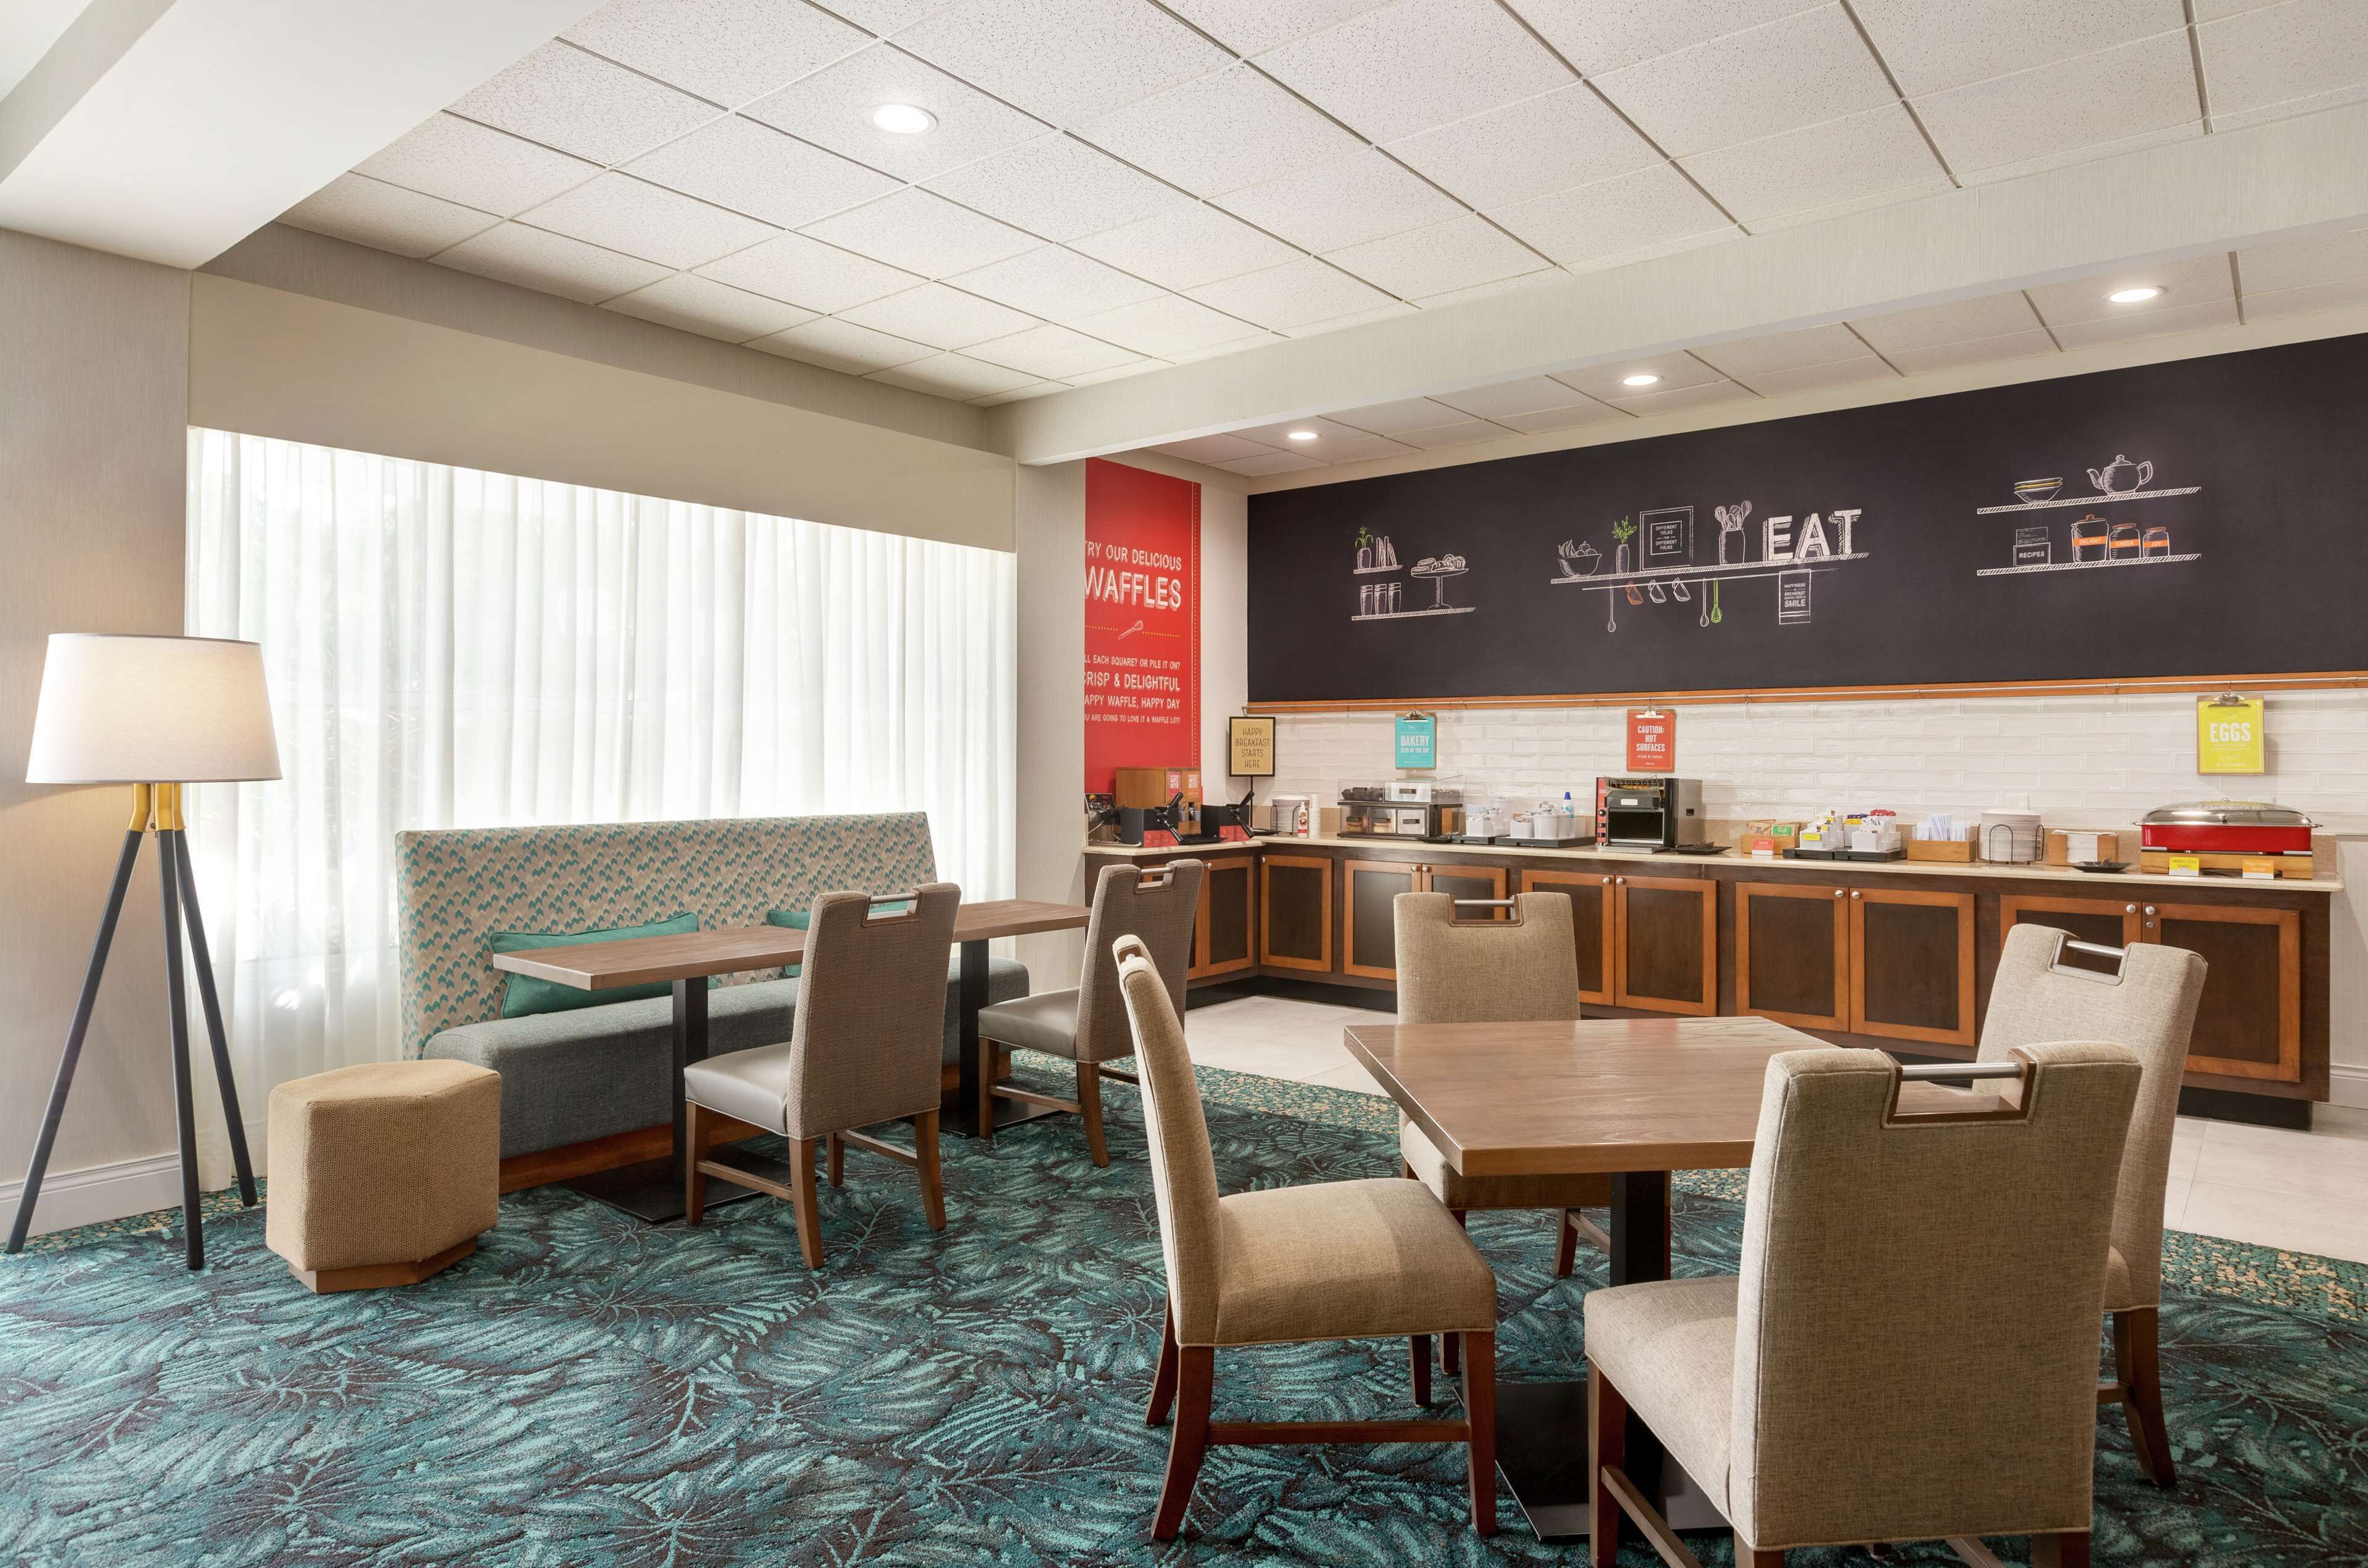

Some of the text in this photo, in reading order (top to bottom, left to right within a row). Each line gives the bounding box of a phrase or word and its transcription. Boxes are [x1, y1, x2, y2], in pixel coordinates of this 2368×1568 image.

[1763, 509, 1862, 561] EAT
[1085, 540, 1181, 571] RY OUR DELICIOUS
[1085, 566, 1181, 611] WAFFLES
[1784, 599, 1806, 608] SMILE
[1093, 654, 1109, 665] EACH
[1111, 656, 1137, 667] SQUARE?
[1140, 658, 1148, 667] OR
[1150, 660, 1161, 669] PILE
[1163, 661, 1167, 669] IT
[1170, 661, 1181, 671] ON?
[1114, 672, 1120, 688] &
[1124, 674, 1181, 691] DELIGHTFUL
[1084, 694, 1181, 710] APPY WAFFLE, HAPPY DAY
[1638, 725, 1665, 734] CAUTION:
[2210, 722, 2251, 742] EGGS
[1236, 738, 1270, 746] BREAKFAST
[1400, 735, 1429, 746] BAKERY
[1645, 734, 1657, 743] HOT
[1241, 749, 1264, 757] STARTS
[1636, 743, 1665, 752] SURFACES
[1244, 760, 1260, 768] HERE
